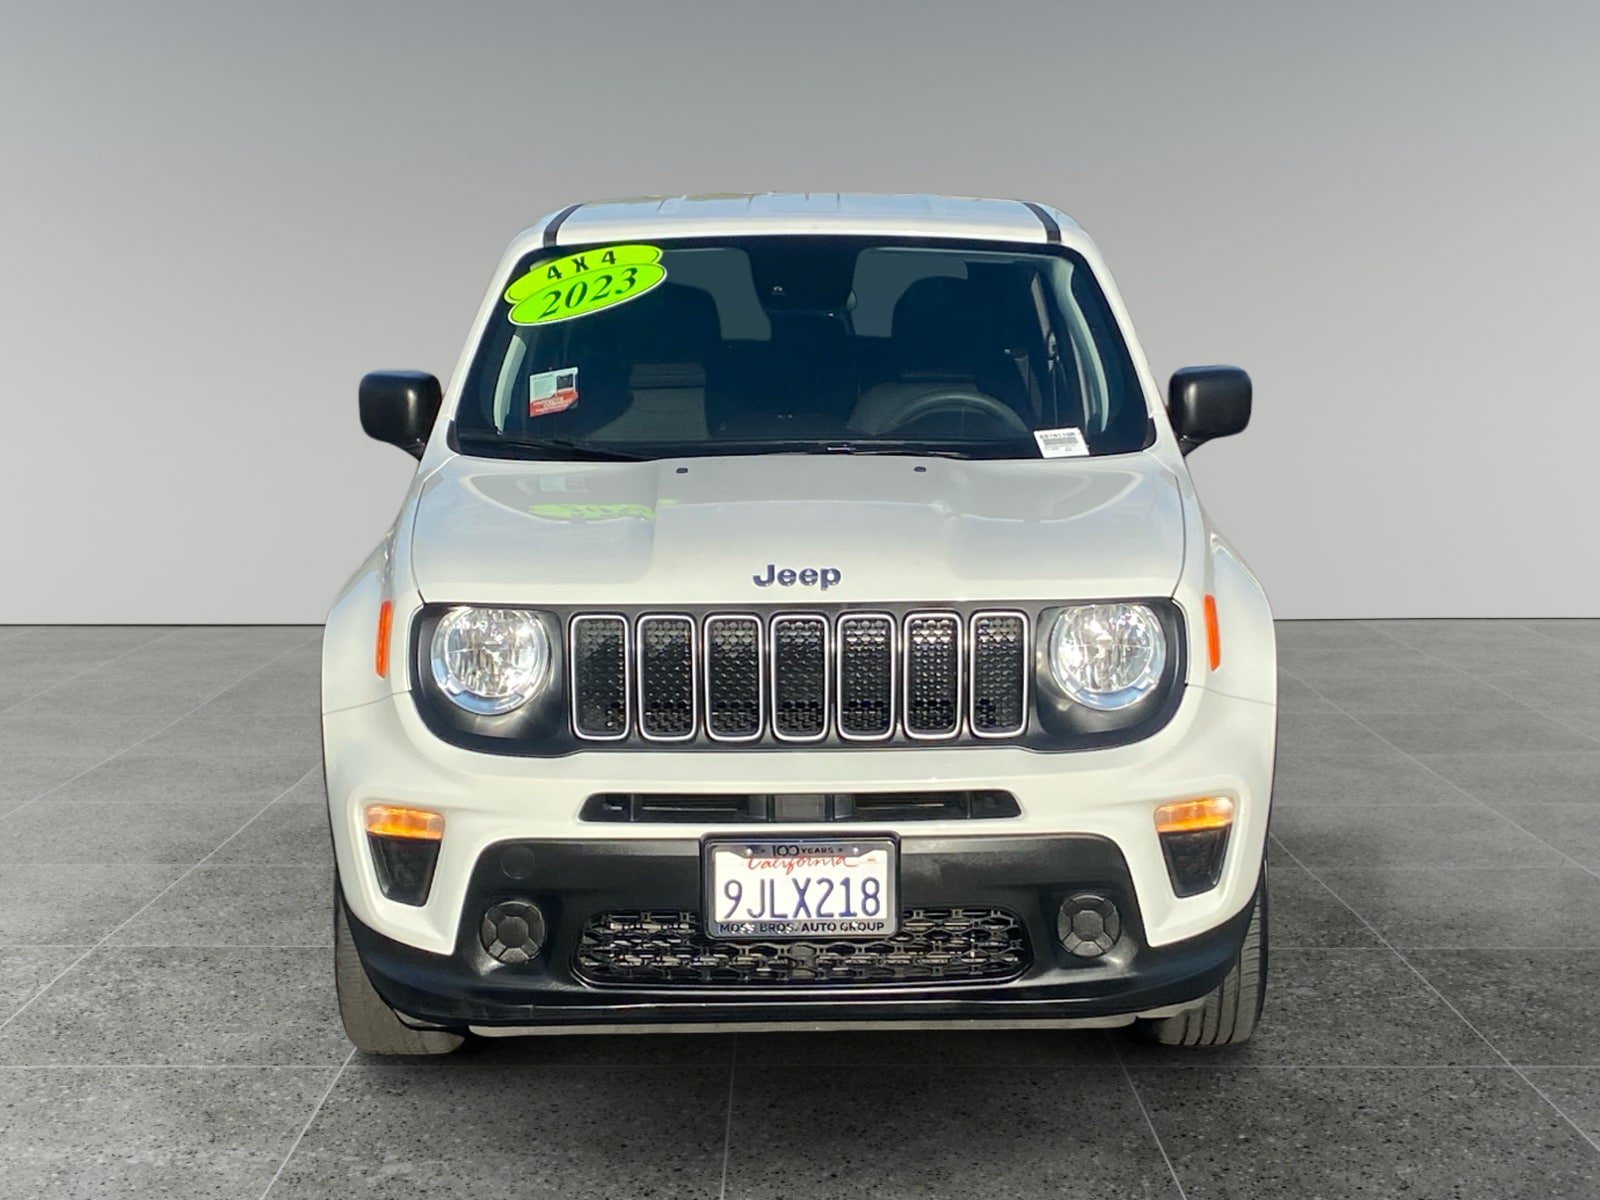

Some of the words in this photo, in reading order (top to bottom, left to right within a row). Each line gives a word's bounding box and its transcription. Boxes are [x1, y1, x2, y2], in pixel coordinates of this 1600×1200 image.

[539, 267, 638, 319] 2023
[753, 564, 842, 591] Jeep
[772, 845, 800, 857] 100
[802, 846, 834, 855] YEARS
[723, 876, 881, 920] 9JLX218
[719, 922, 755, 935] MOSS
[801, 922, 837, 933] AUTO
[840, 921, 885, 933] GROUP
